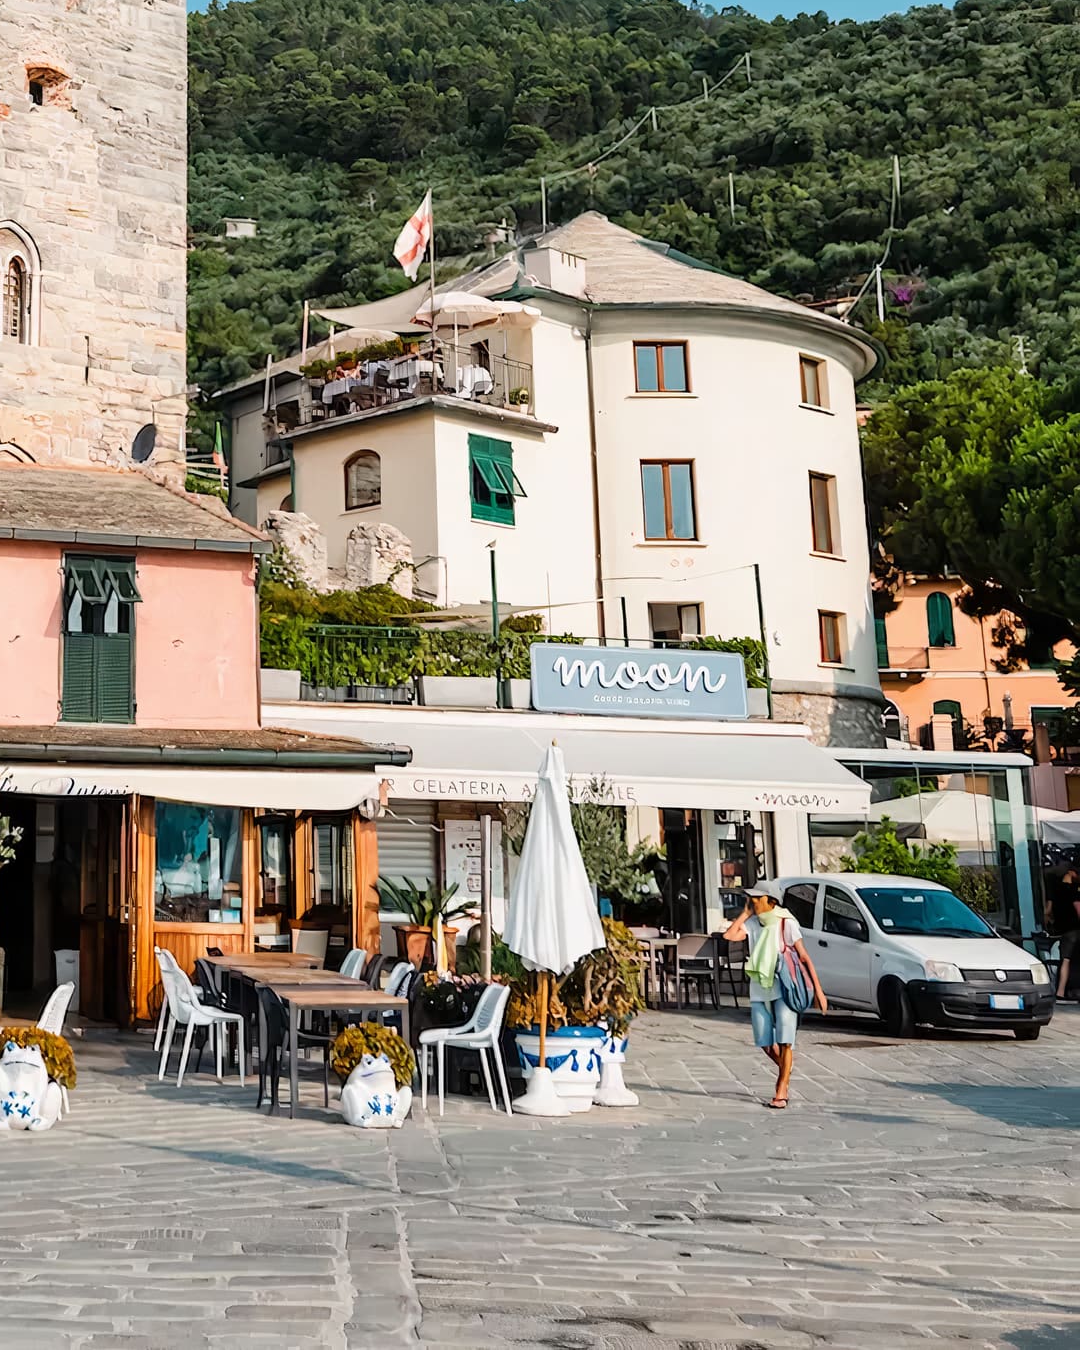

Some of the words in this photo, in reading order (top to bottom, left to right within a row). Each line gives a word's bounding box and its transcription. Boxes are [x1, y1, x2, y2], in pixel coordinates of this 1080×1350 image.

[552, 656, 727, 693] moon
[413, 779, 508, 795] GELATERIA
[762, 793, 832, 807] moon
